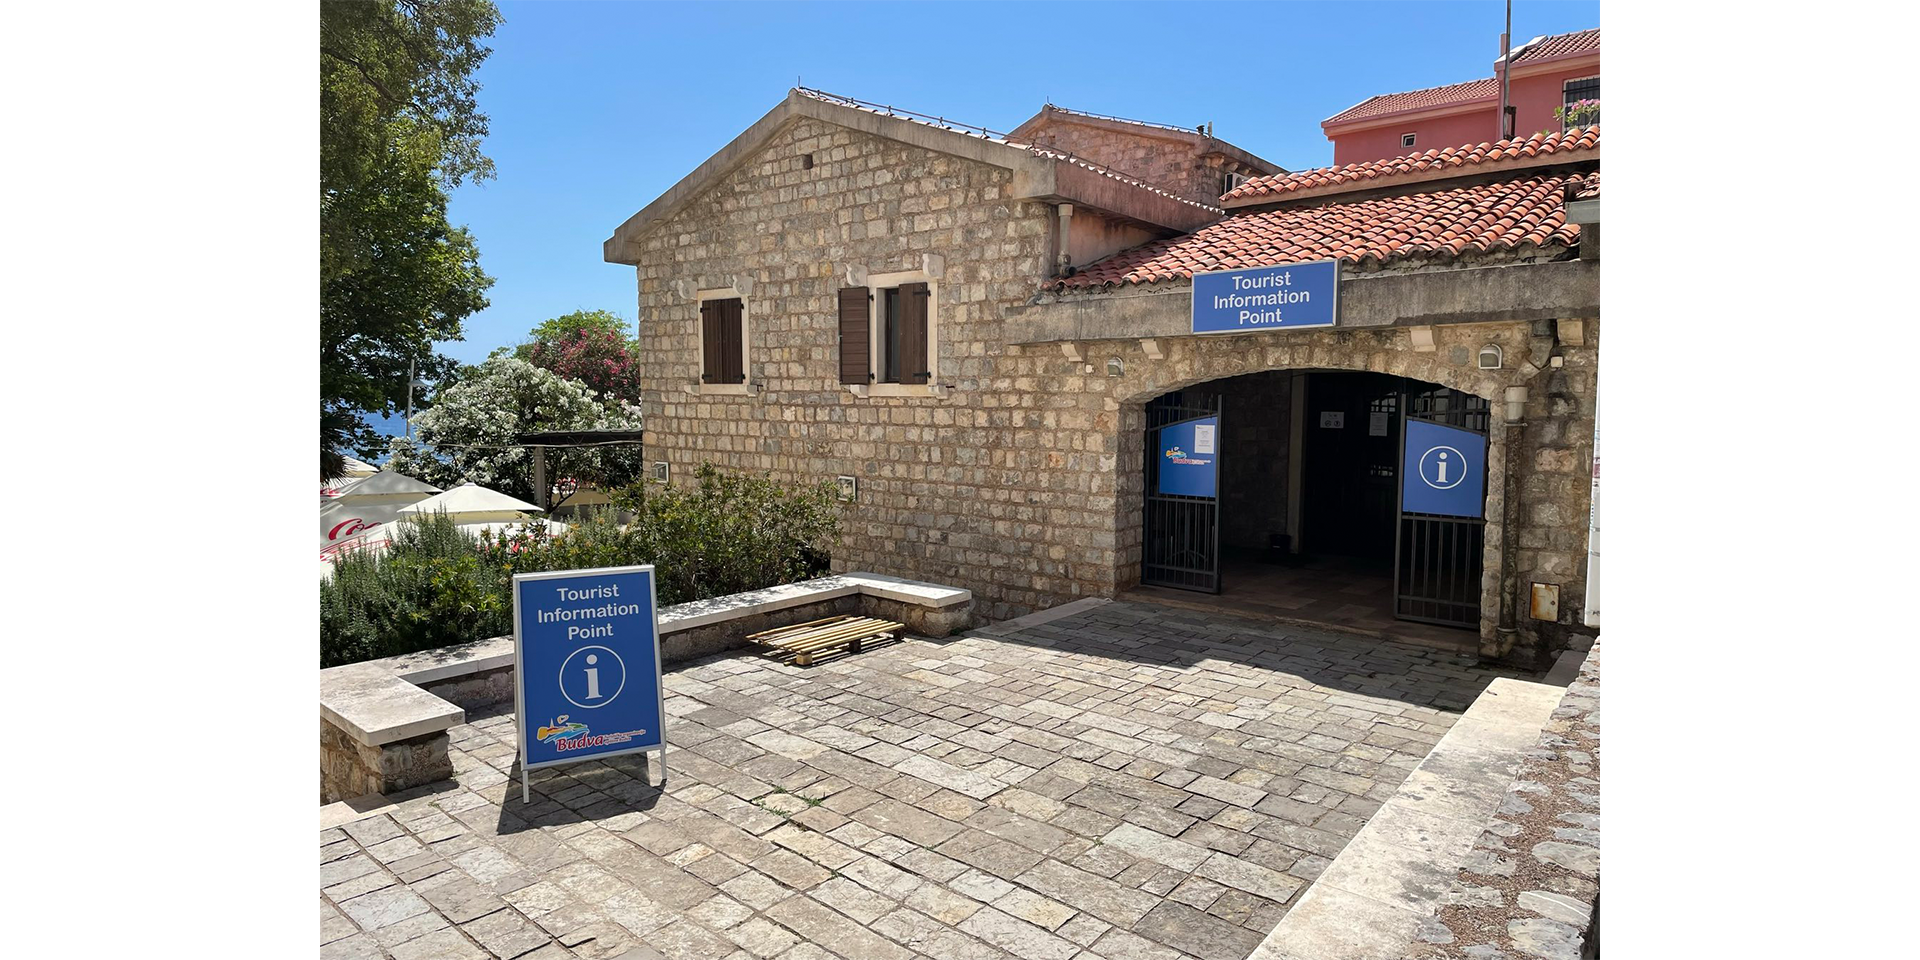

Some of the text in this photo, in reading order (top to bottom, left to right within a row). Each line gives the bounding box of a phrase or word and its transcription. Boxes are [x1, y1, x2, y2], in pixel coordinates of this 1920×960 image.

[1231, 271, 1292, 291] Tourist
[1214, 290, 1310, 309] Information
[1239, 308, 1283, 325] Point
[557, 584, 619, 601] Tourist
[538, 603, 639, 623] Information
[568, 623, 614, 640] Point
[556, 733, 604, 752] Budva
